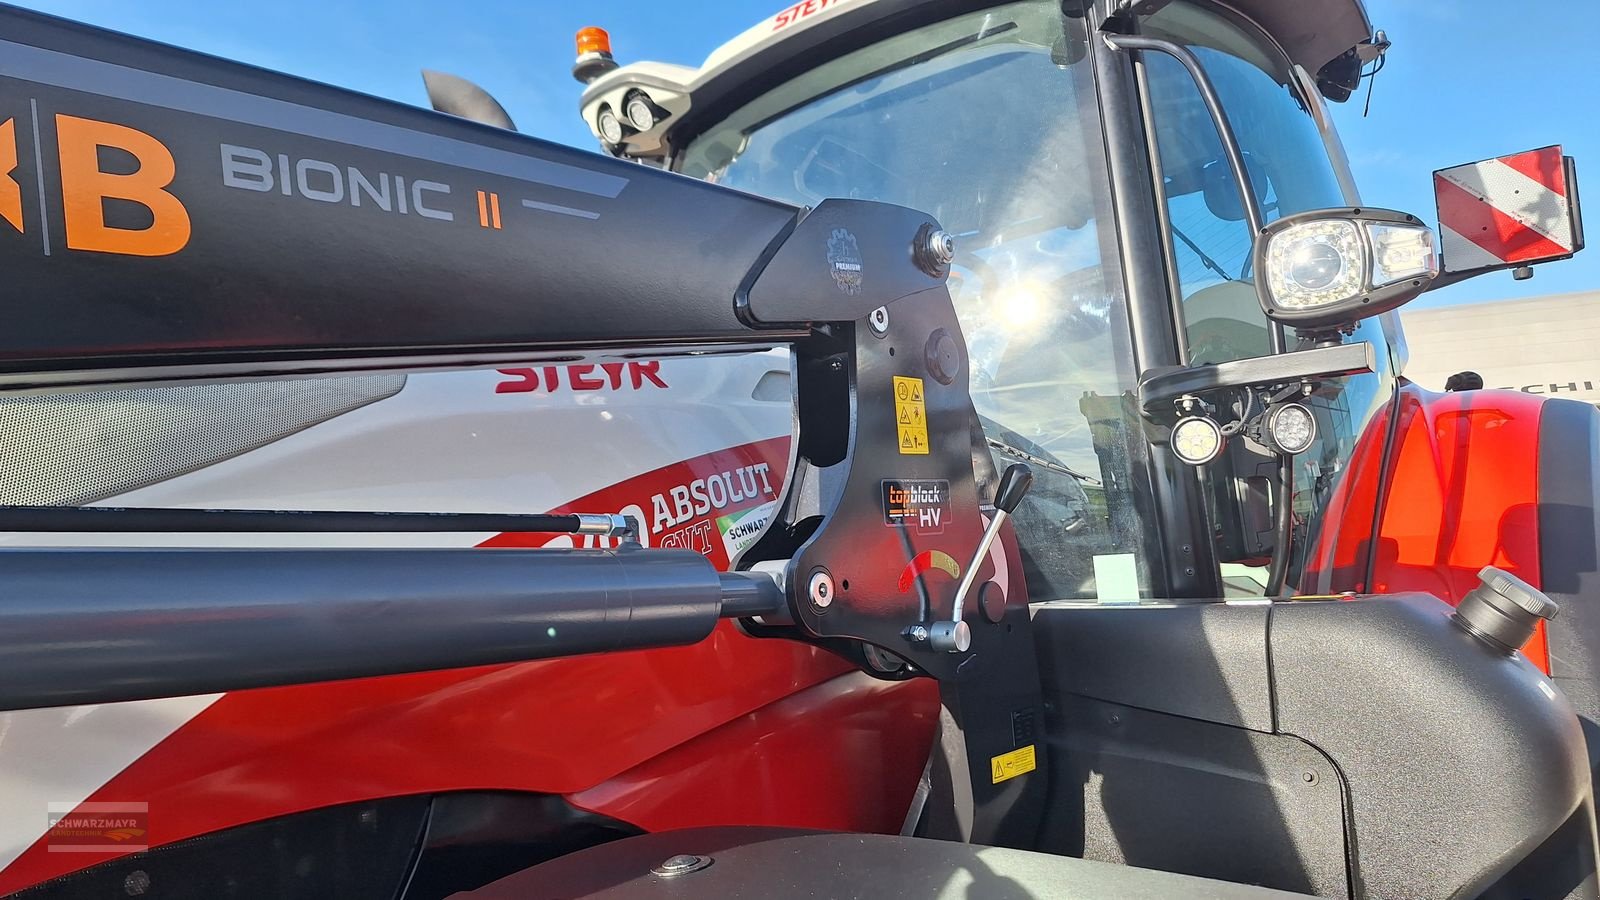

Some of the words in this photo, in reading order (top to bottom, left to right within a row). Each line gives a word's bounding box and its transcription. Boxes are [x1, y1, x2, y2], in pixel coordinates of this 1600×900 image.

[771, 0, 839, 31] STEY
[220, 143, 454, 222] BIONIC
[476, 190, 503, 230] II
[835, 262, 861, 272] PREMIUM
[495, 361, 670, 394] STEYR
[652, 463, 773, 534] ABSOLUT
[889, 486, 941, 508] topblock
[920, 508, 941, 527] HV
